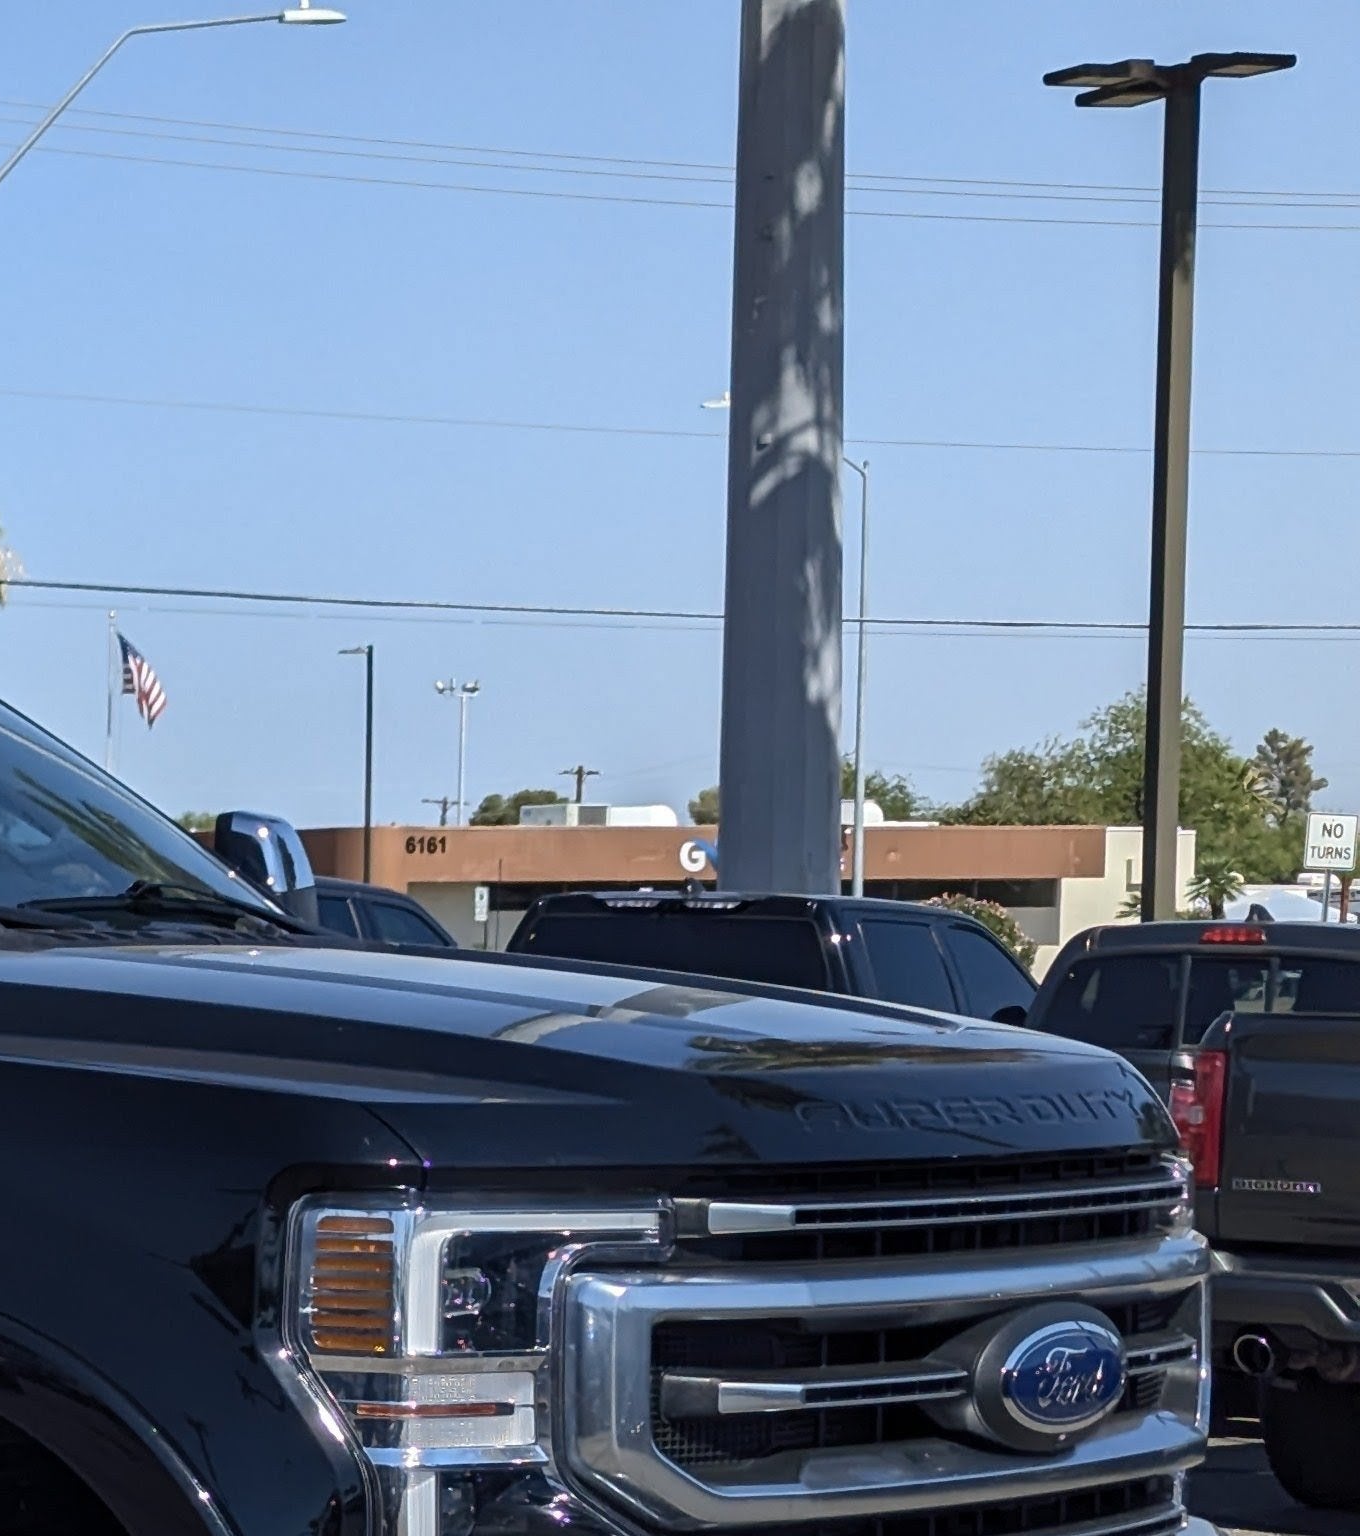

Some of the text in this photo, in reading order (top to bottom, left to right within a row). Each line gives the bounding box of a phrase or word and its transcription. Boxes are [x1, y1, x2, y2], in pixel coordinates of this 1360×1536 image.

[1322, 822, 1344, 839] NO
[405, 836, 446, 854] 6161
[1310, 845, 1352, 860] TURNS
[1037, 1346, 1105, 1408] Ford
